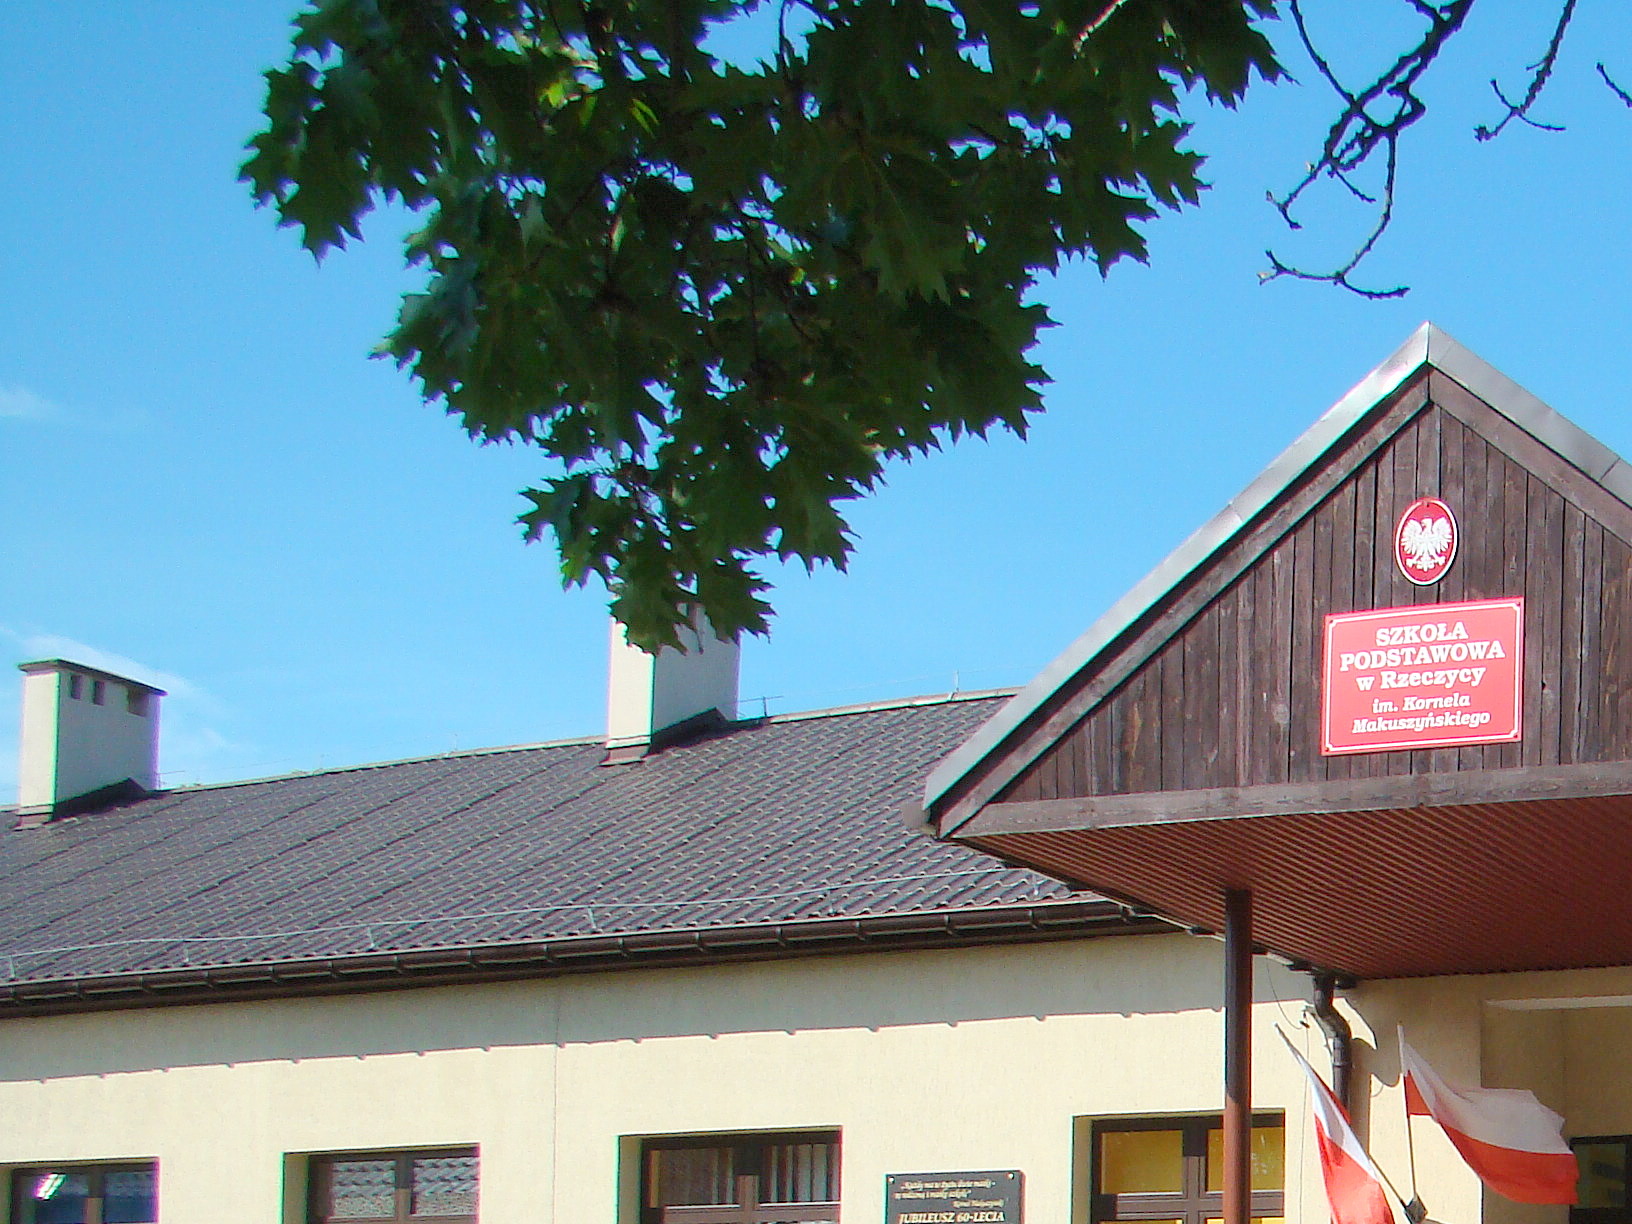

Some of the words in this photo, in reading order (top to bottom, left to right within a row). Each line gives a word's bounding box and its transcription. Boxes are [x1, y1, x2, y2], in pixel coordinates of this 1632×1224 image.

[1376, 622, 1469, 646] SZKOŁA
[1340, 640, 1506, 672] PODSTAWOWA
[1356, 676, 1375, 691] w
[1380, 667, 1486, 689] Rzeczycy
[1372, 698, 1399, 714] im.
[1402, 692, 1471, 712] Kornela
[1352, 711, 1491, 734] Makuszyńskiego
[899, 1212, 955, 1224] JUBILEUSZ
[957, 1210, 1004, 1223] 60-LECIA
